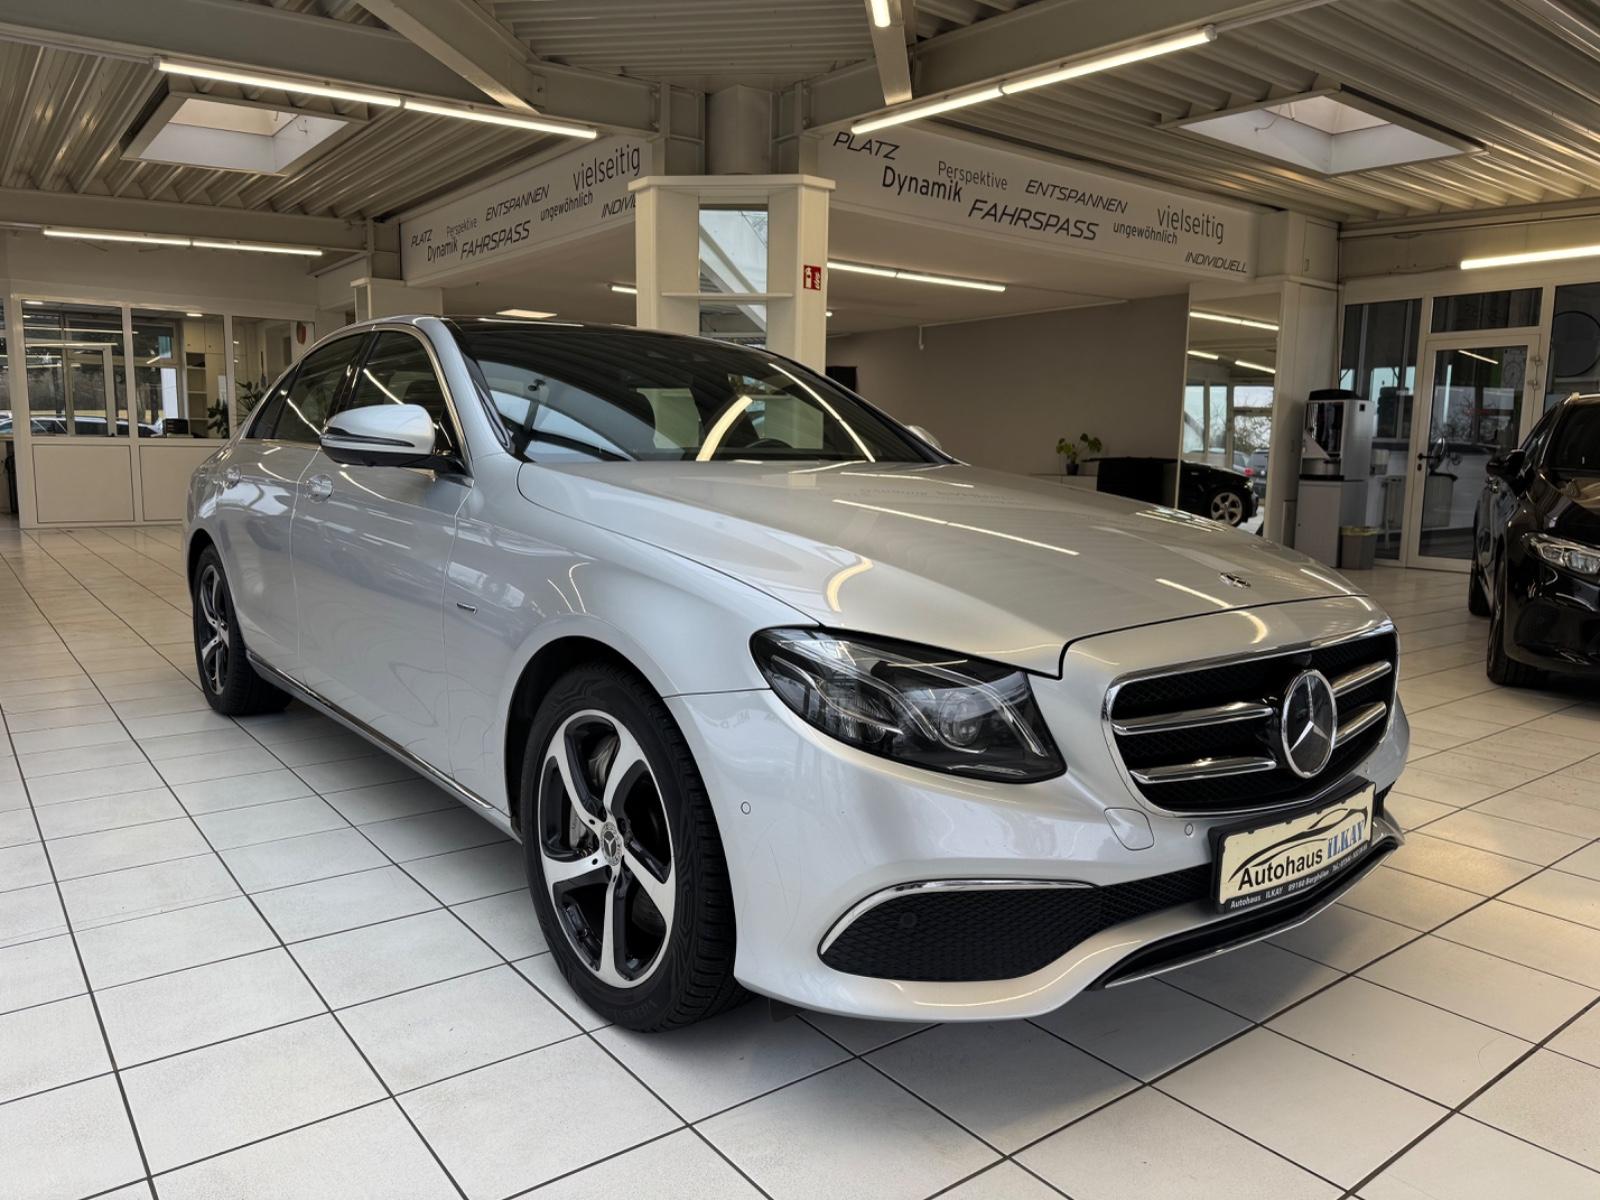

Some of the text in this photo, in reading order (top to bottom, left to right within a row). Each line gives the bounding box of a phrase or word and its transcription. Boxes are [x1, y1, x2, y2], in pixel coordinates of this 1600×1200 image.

[833, 131, 900, 160] PLATZ
[572, 143, 641, 191] vielseitig
[937, 160, 1008, 192] Perspektive
[881, 165, 963, 203] Dynamik
[1024, 179, 1128, 215] ENTSPANNEN
[485, 184, 550, 222] ENTSPANNEN
[540, 191, 593, 223] ungewöhnlich
[446, 216, 478, 237] Perspektive
[968, 198, 1099, 241] FAHRSPASS
[1112, 222, 1178, 246] ungewöhnlich
[1156, 205, 1225, 245] vielseitig
[411, 228, 433, 248] PLATZ
[427, 237, 458, 263] Dynamik
[460, 219, 531, 260] FAHRSPASS
[1184, 251, 1248, 274] INDIVIDUELL
[1238, 848, 1323, 891] Autohaus
[1230, 895, 1261, 908] Autohaus
